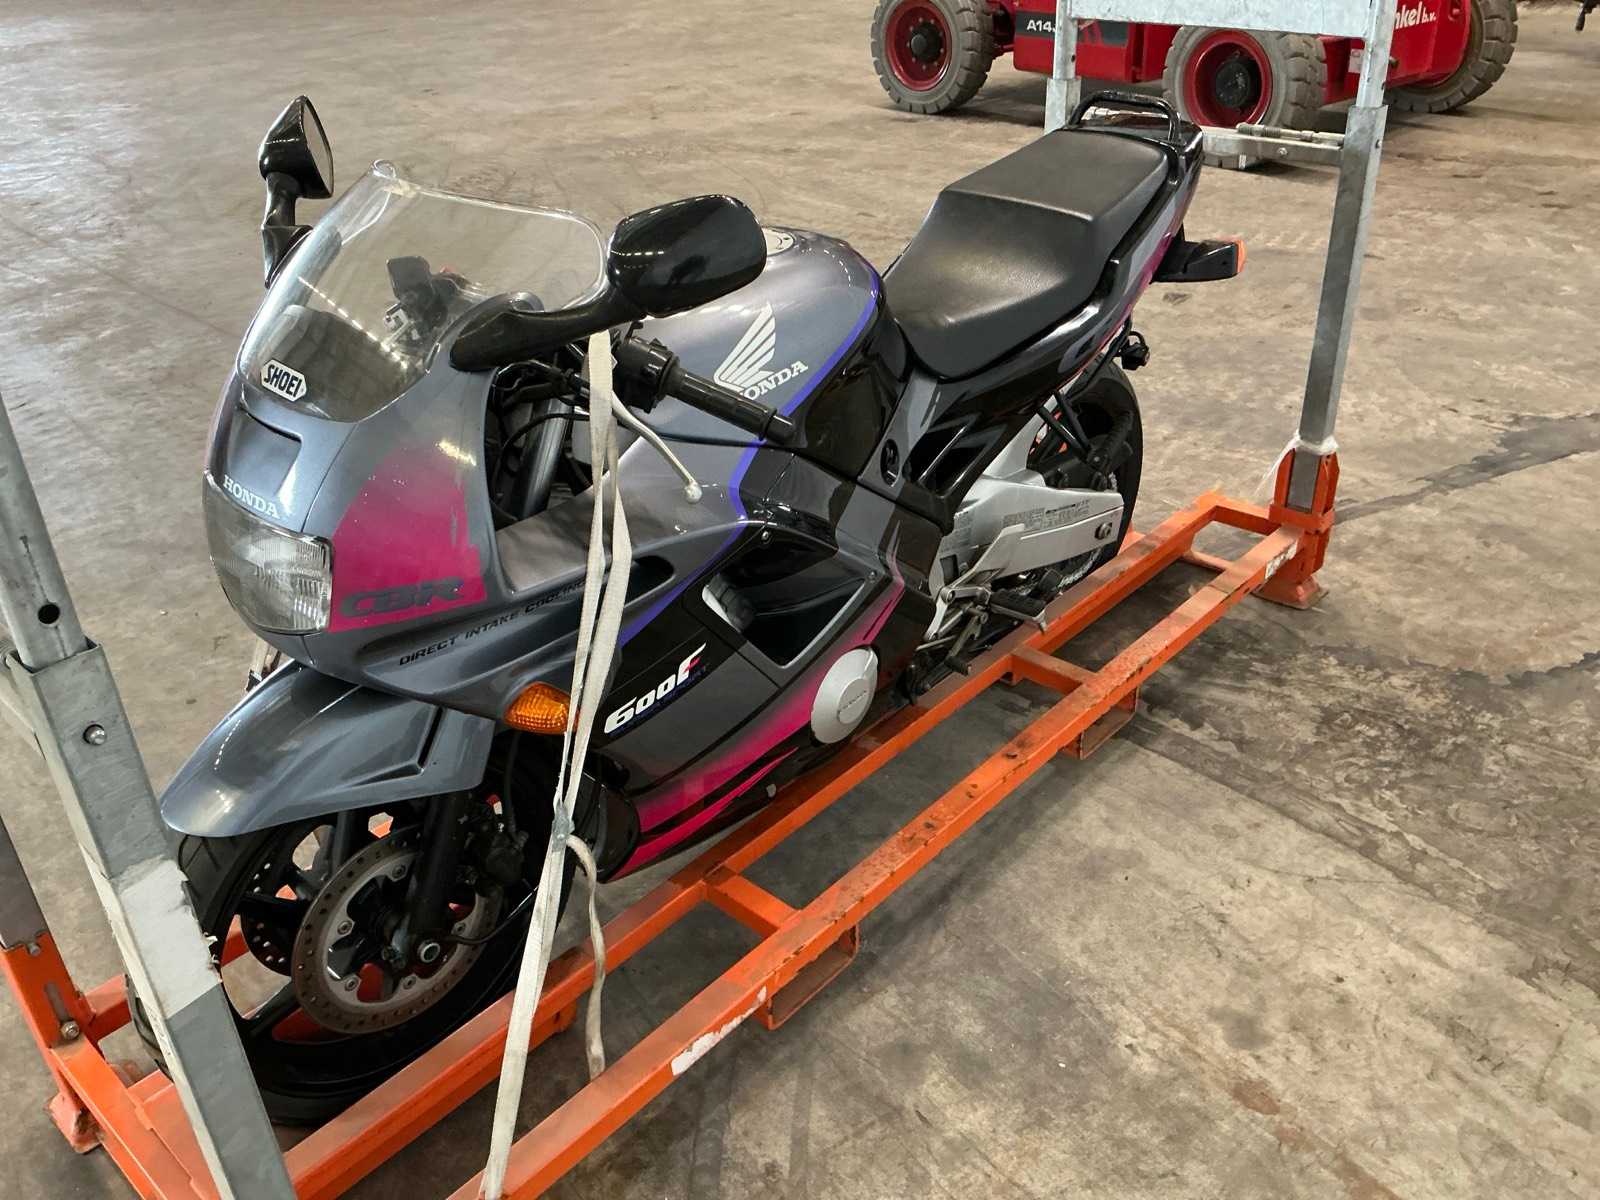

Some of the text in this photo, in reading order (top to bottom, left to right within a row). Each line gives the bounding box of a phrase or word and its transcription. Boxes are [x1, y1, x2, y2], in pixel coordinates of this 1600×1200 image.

[264, 364, 302, 397] SHOEI
[740, 361, 809, 400] ONDA
[223, 474, 280, 519] HONDA
[340, 576, 464, 618] CBR
[399, 635, 459, 666] DIRECT
[465, 613, 520, 639] INTAKE
[604, 641, 707, 734] 600F
